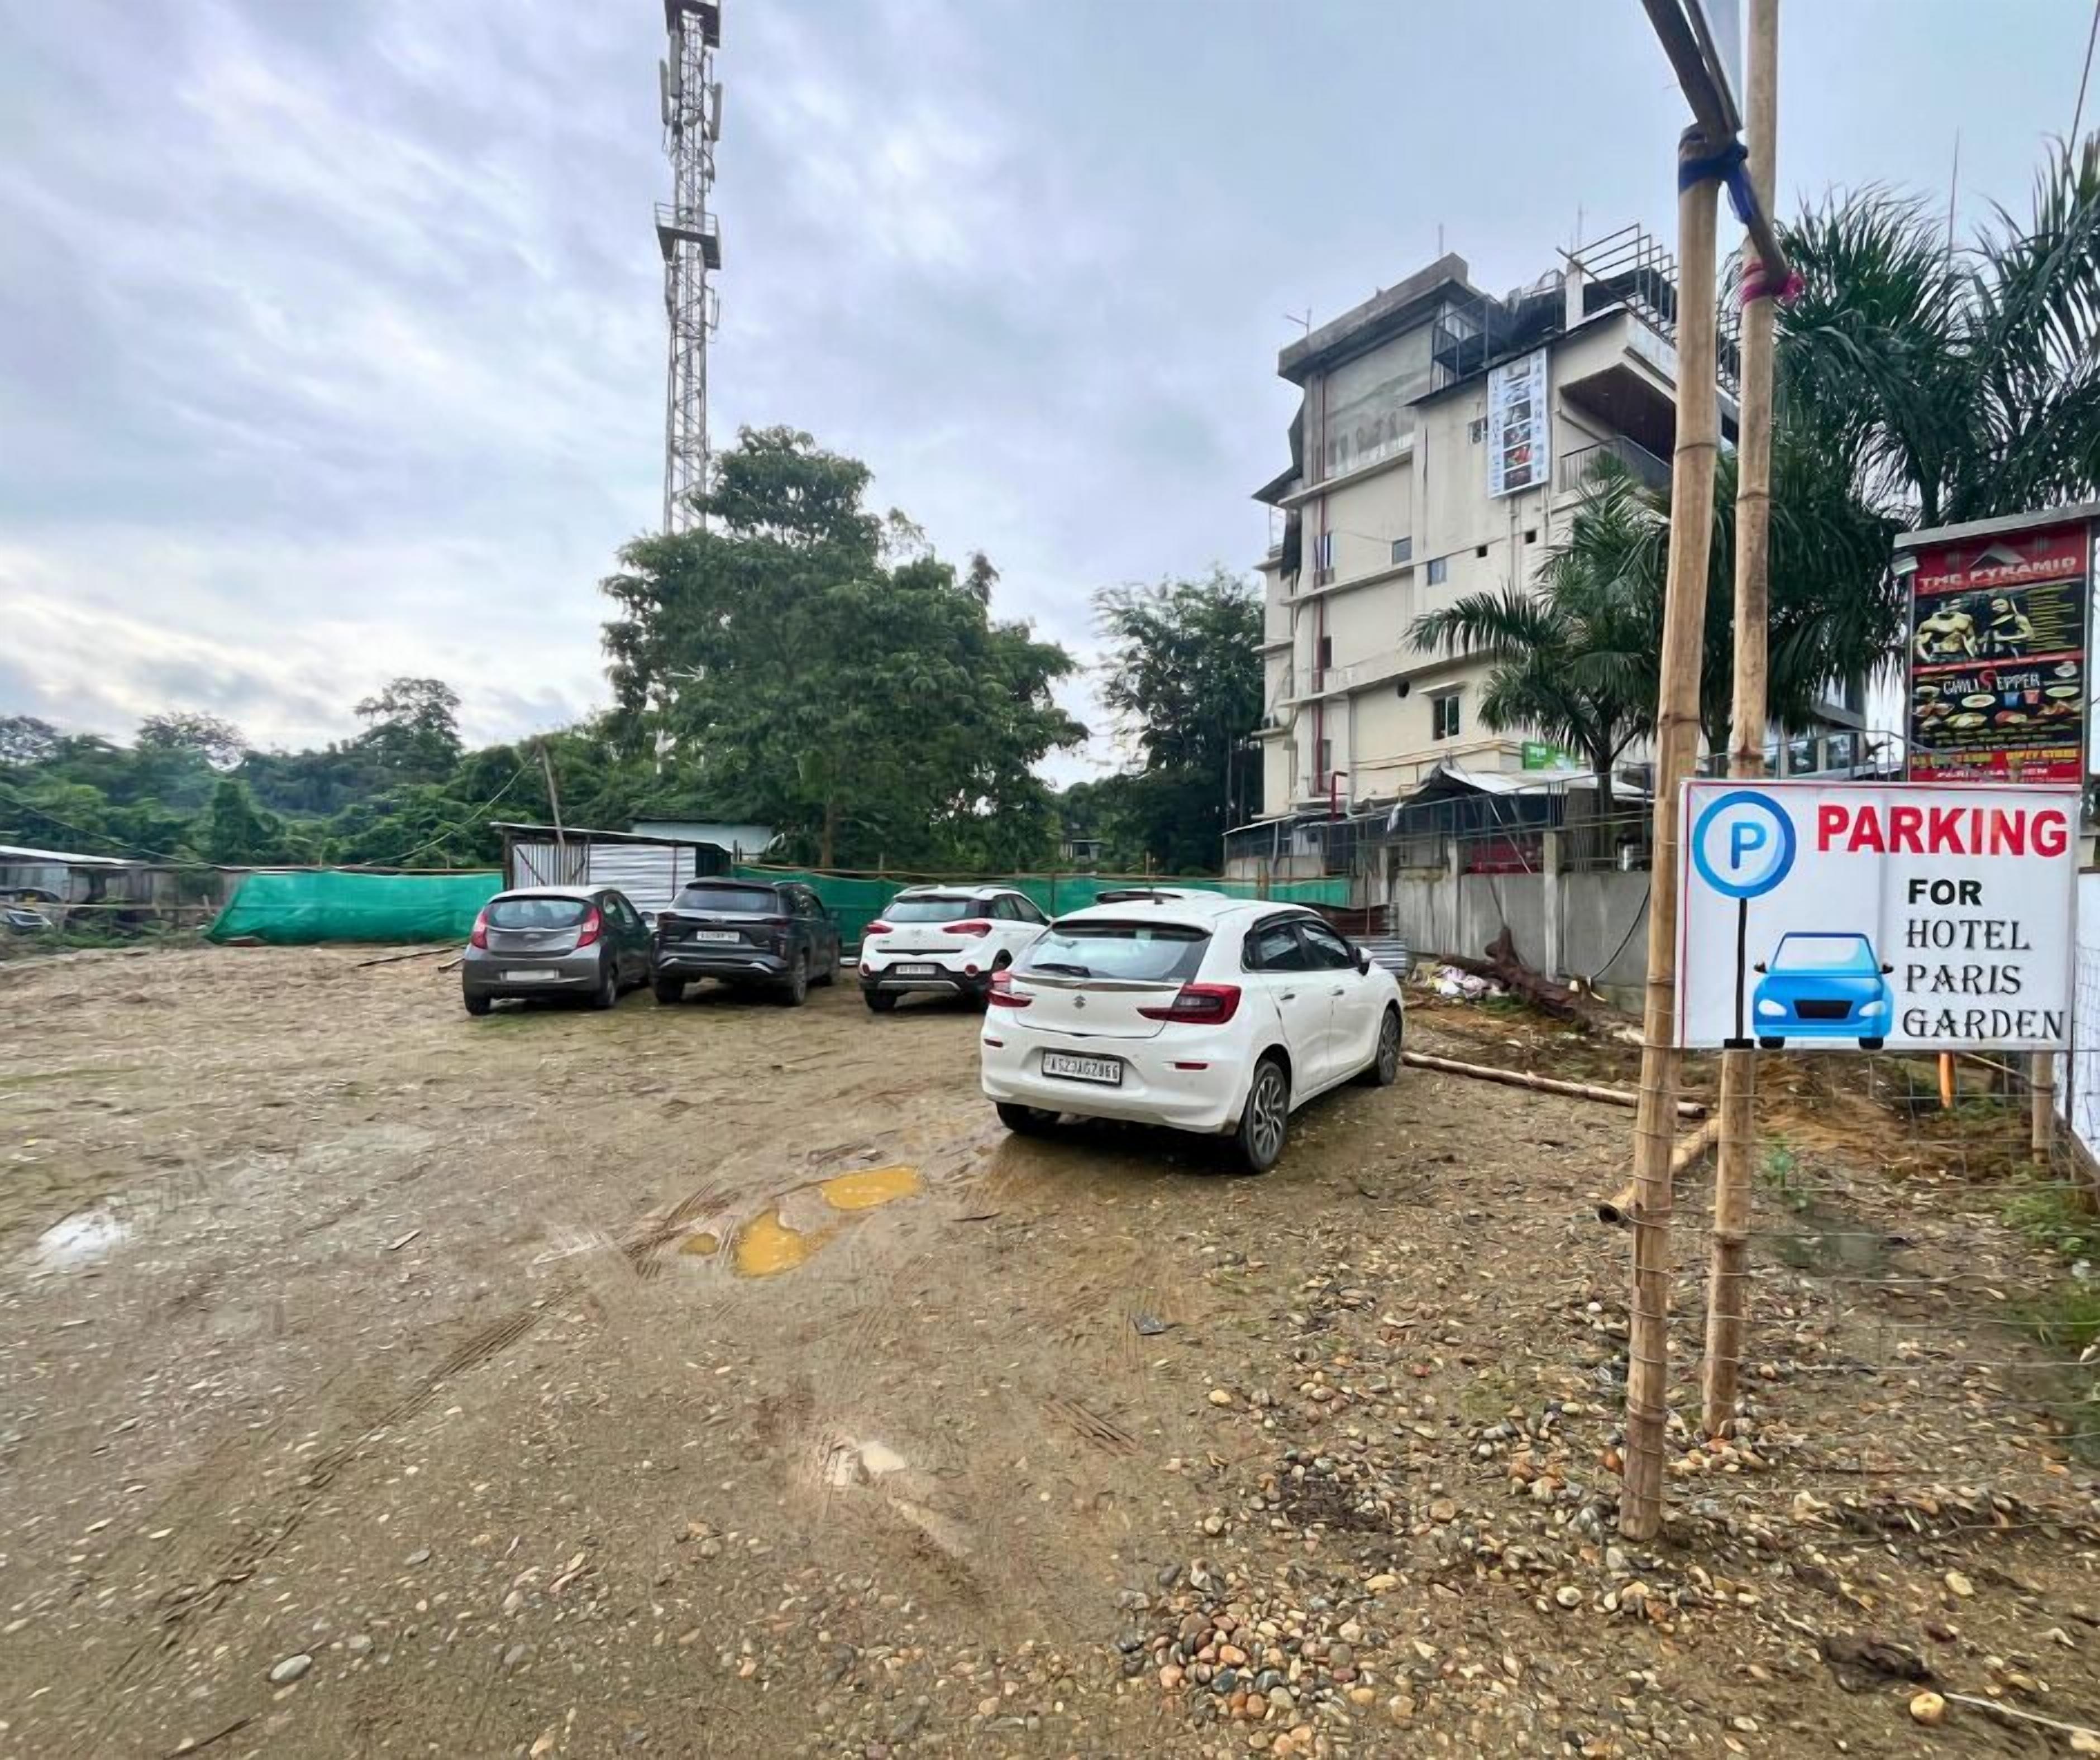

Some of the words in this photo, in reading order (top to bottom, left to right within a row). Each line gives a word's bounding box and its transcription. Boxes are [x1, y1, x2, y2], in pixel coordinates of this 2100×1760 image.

[1918, 573, 1961, 587] THE
[1731, 821, 1767, 869] P
[1817, 805, 2066, 857] PARKING
[1907, 878, 1983, 906] FOR
[1906, 919, 2033, 950] HOTEL
[1905, 964, 2022, 996] PARIS
[1902, 1007, 2065, 1041] GARDEN
